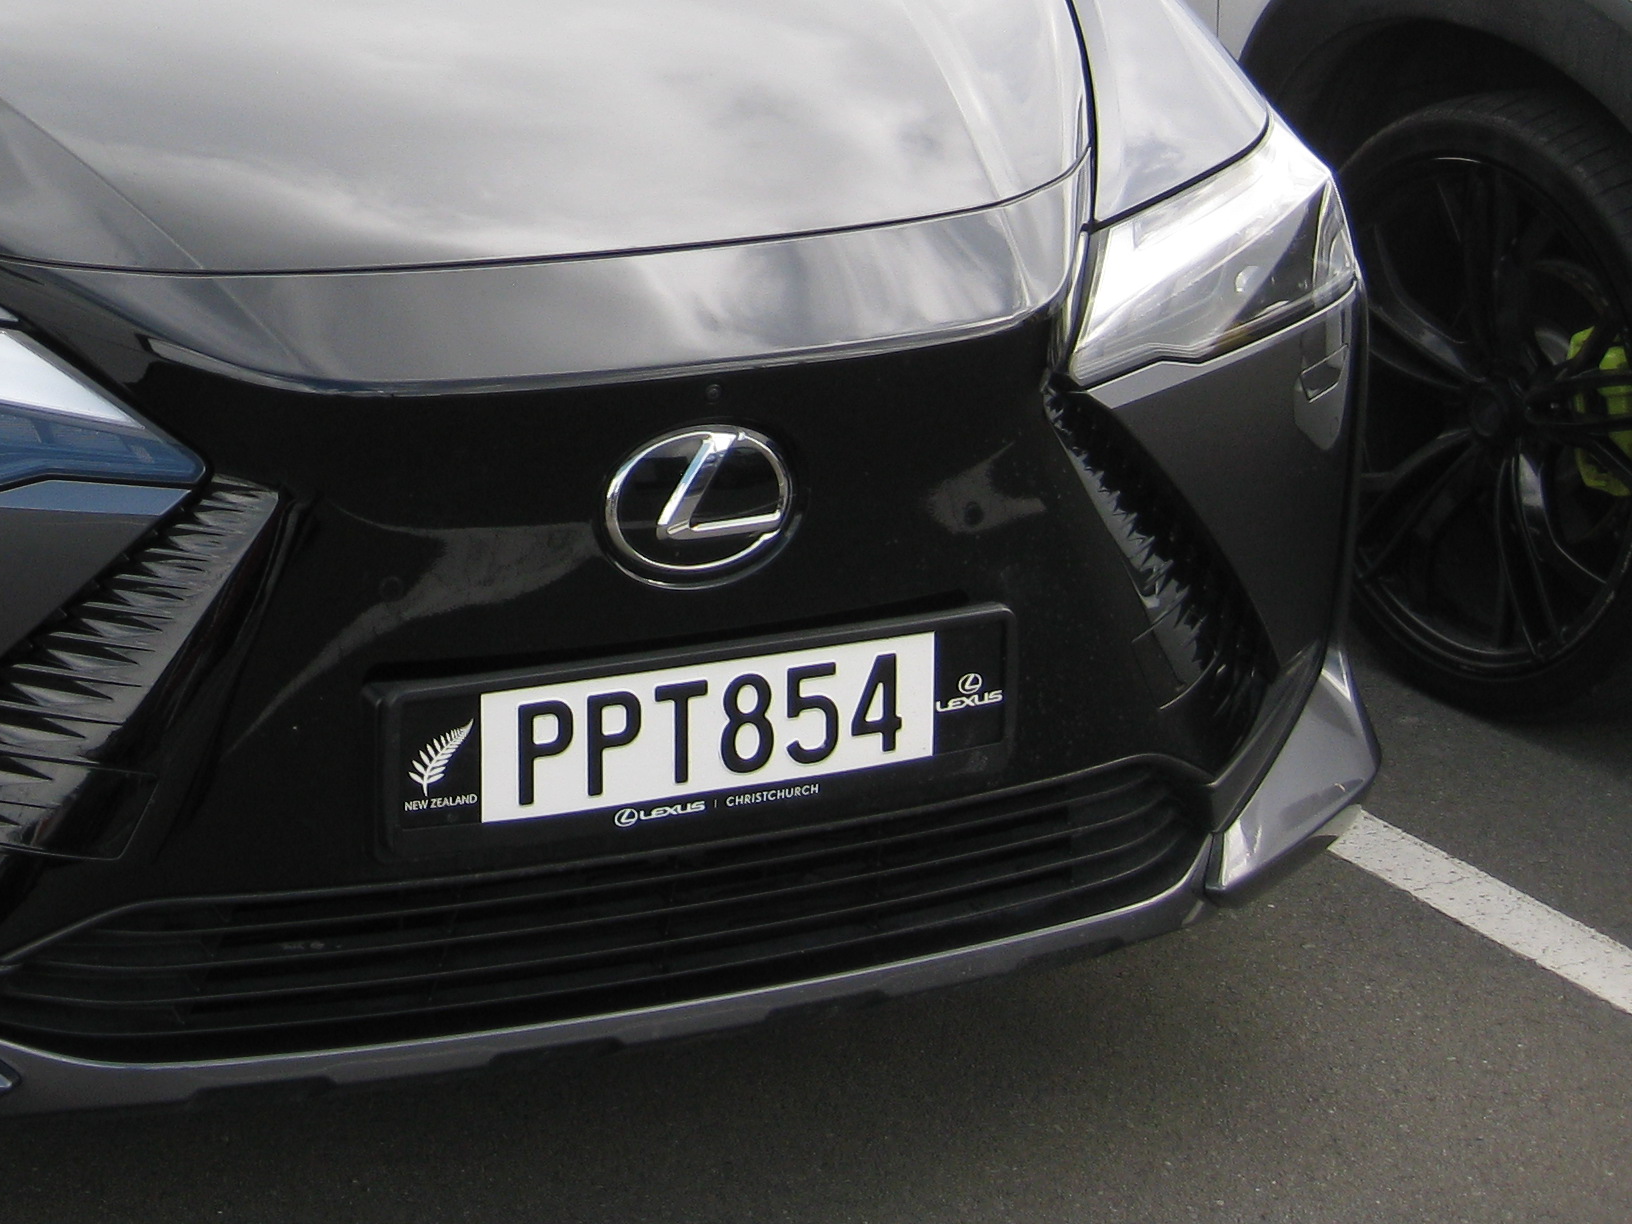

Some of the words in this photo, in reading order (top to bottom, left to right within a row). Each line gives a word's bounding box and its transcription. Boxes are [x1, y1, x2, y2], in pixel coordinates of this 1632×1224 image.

[935, 689, 1004, 713] LEXUS
[517, 653, 903, 807] PPT854
[404, 800, 428, 812] NEW
[430, 793, 478, 808] ZEALAND
[639, 800, 706, 821] LEXUS
[725, 783, 820, 807] CHRISTCHURCH
